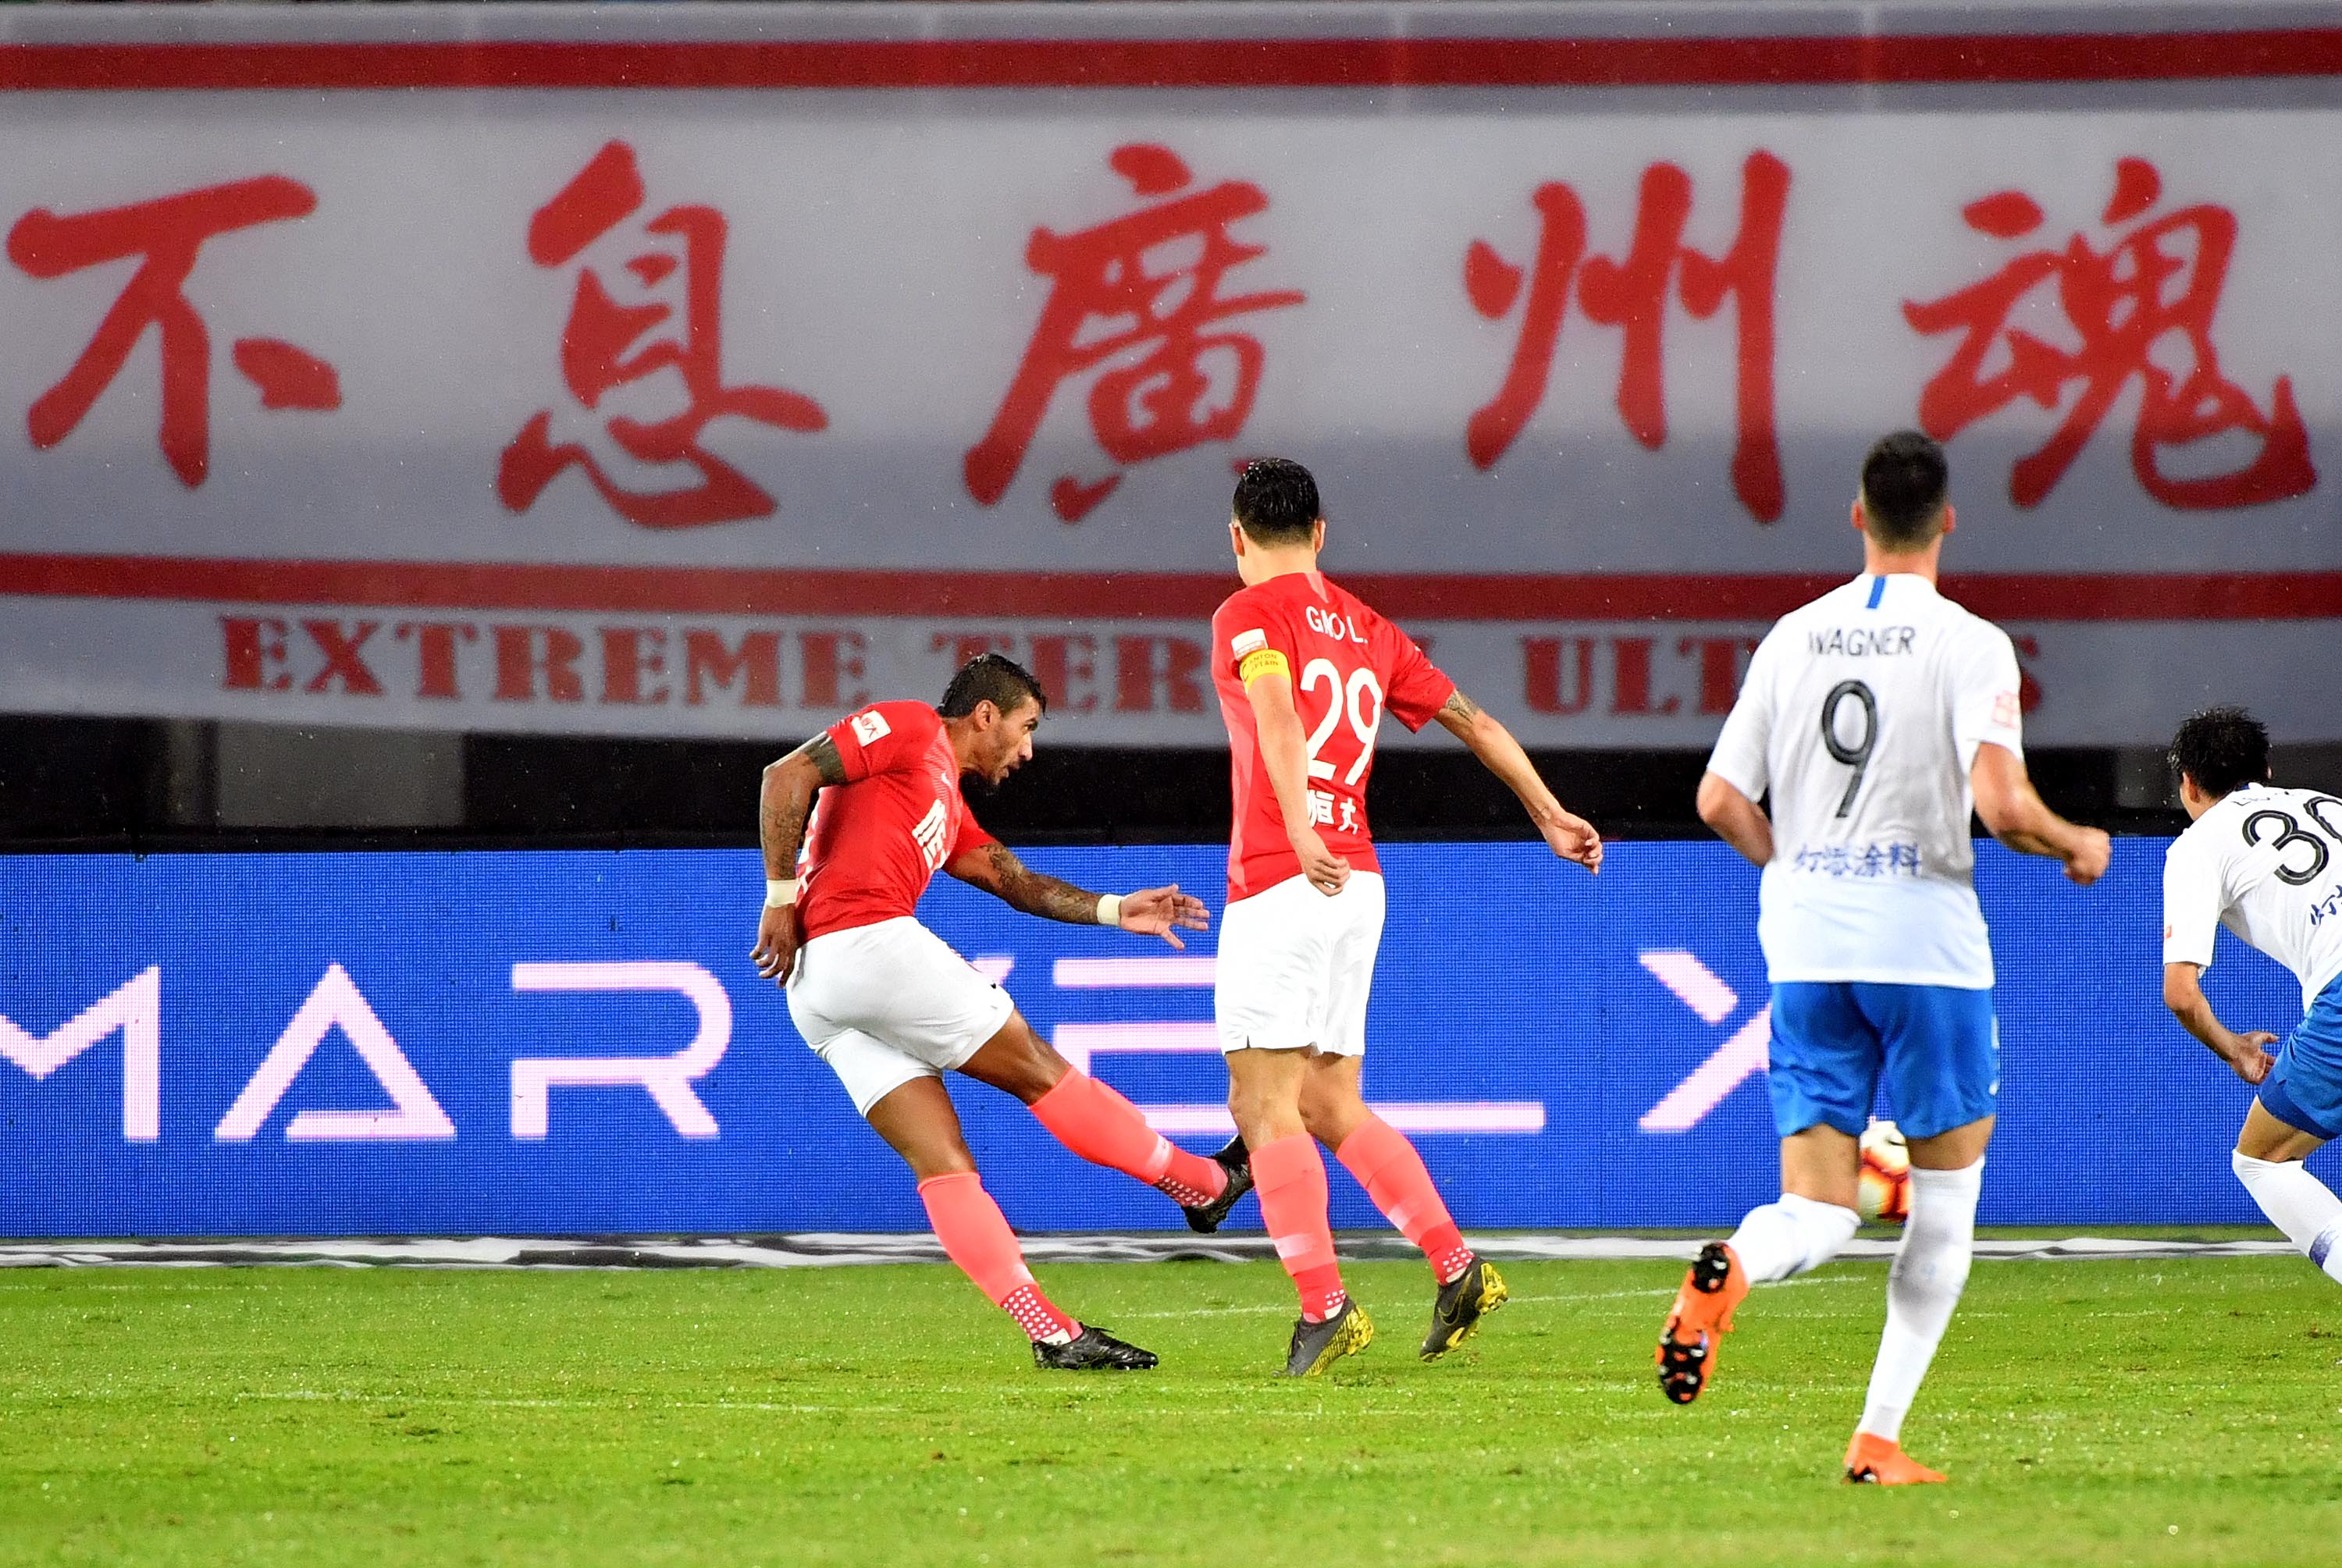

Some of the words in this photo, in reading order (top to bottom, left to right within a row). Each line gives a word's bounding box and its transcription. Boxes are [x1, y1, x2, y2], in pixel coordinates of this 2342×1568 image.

[219, 617, 871, 708] EXTREME
[1346, 615, 1368, 644] L.
[1808, 625, 1916, 656] WAGNER
[1300, 658, 1383, 786] 29
[1822, 680, 1877, 818] 9
